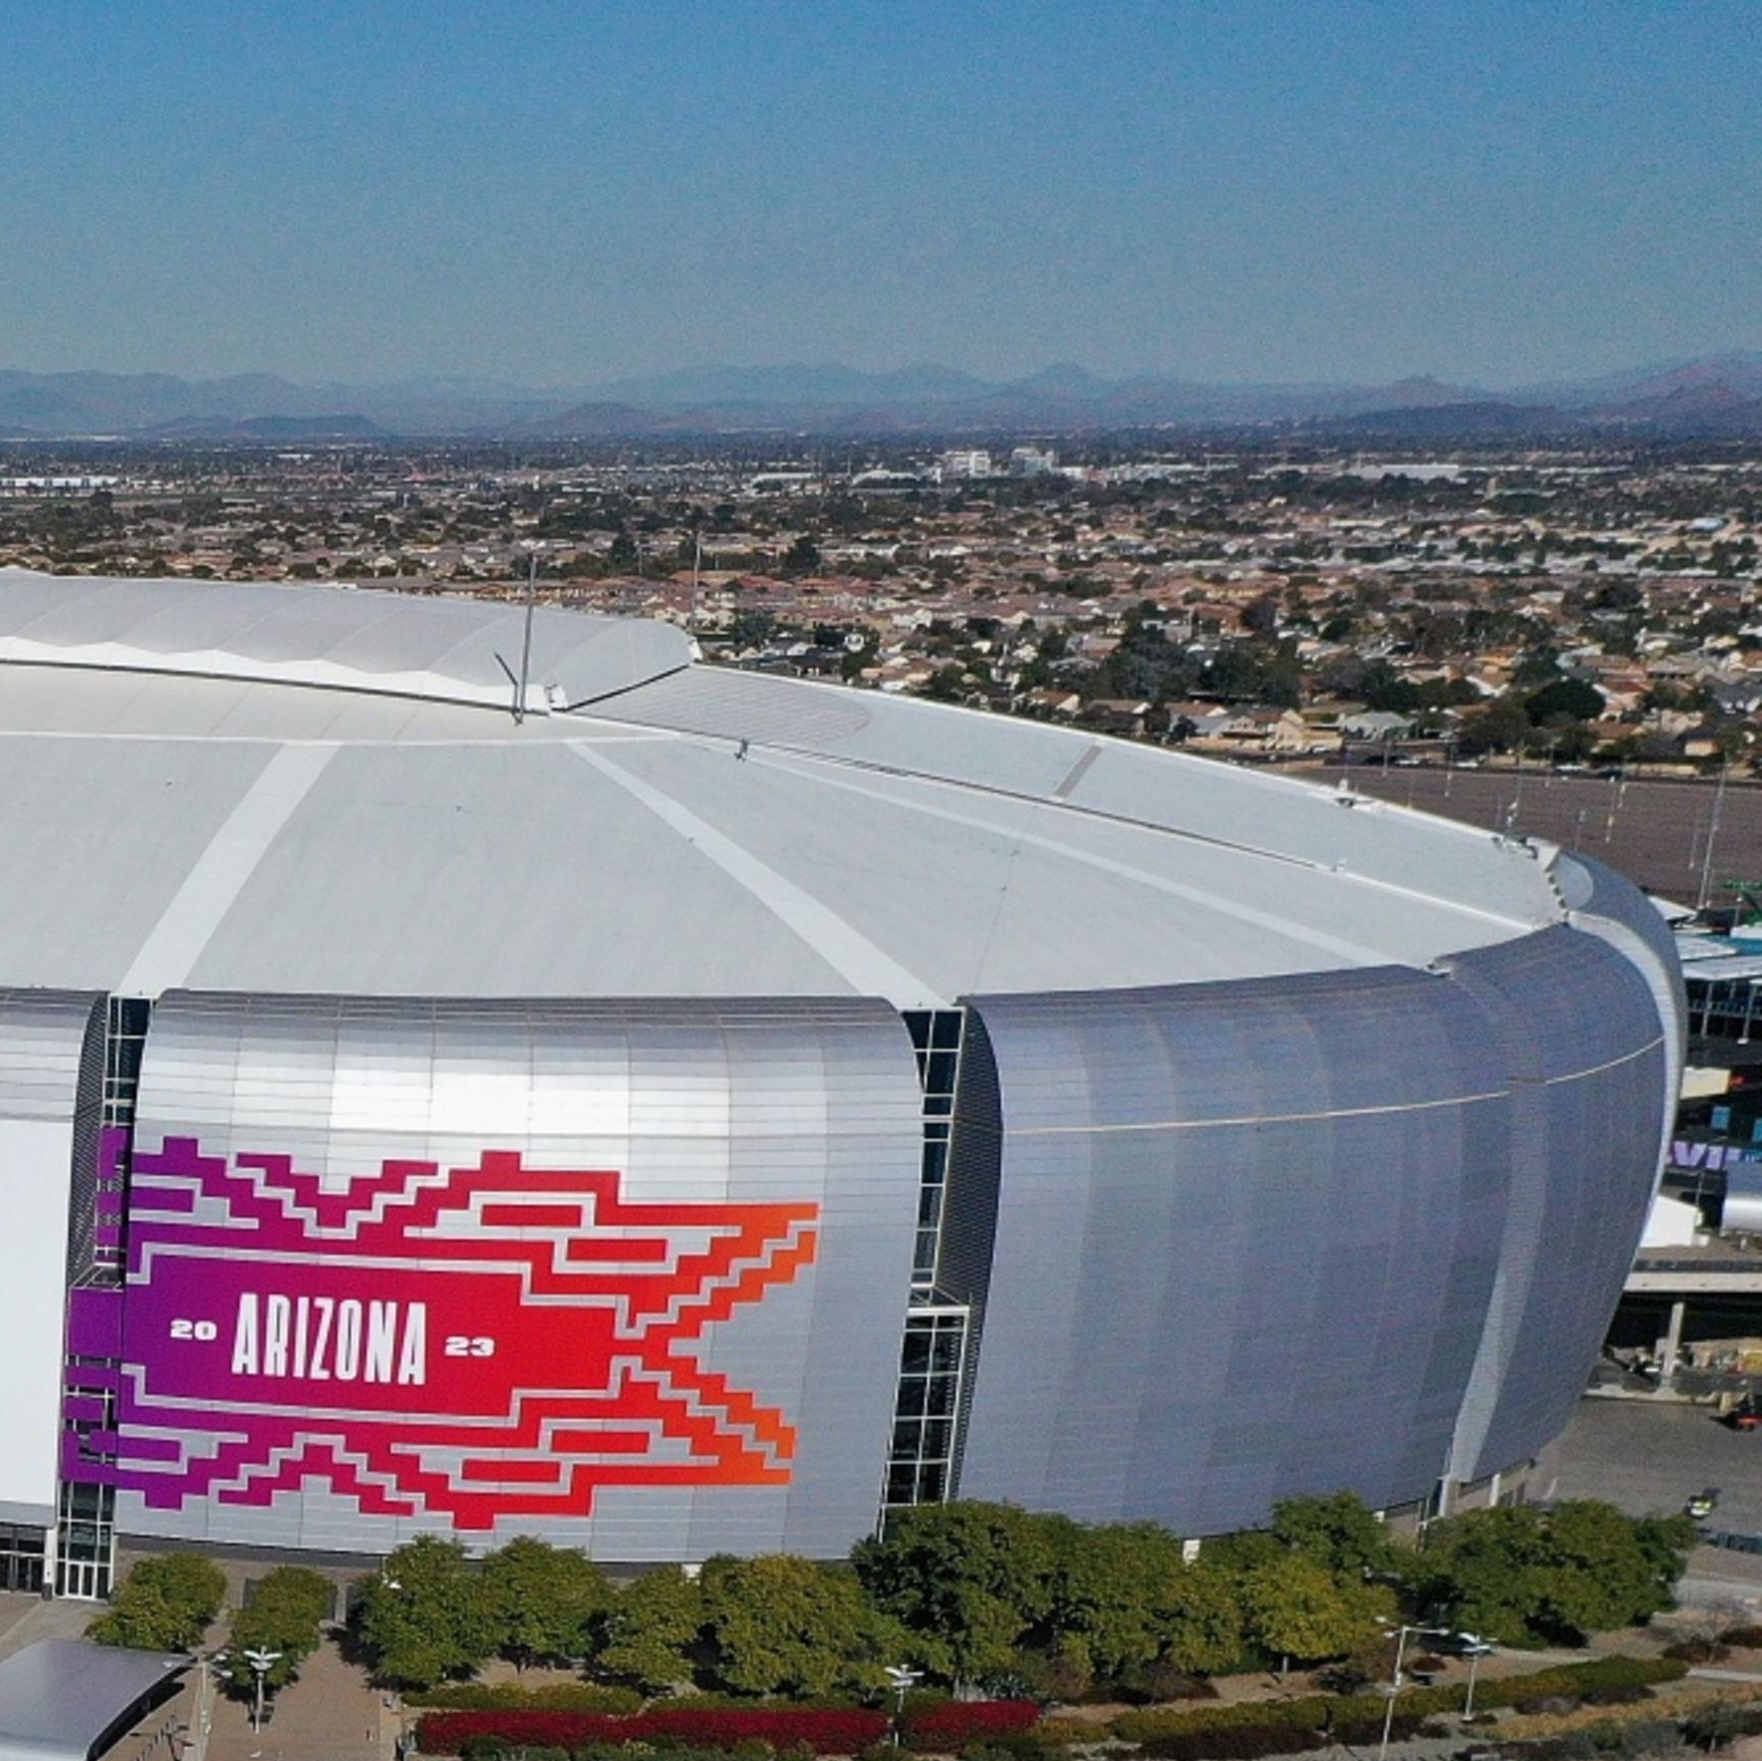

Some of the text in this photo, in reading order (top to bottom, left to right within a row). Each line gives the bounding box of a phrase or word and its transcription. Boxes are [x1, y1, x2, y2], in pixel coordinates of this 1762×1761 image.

[169, 1291, 496, 1386] 20 ARIZONA 23
